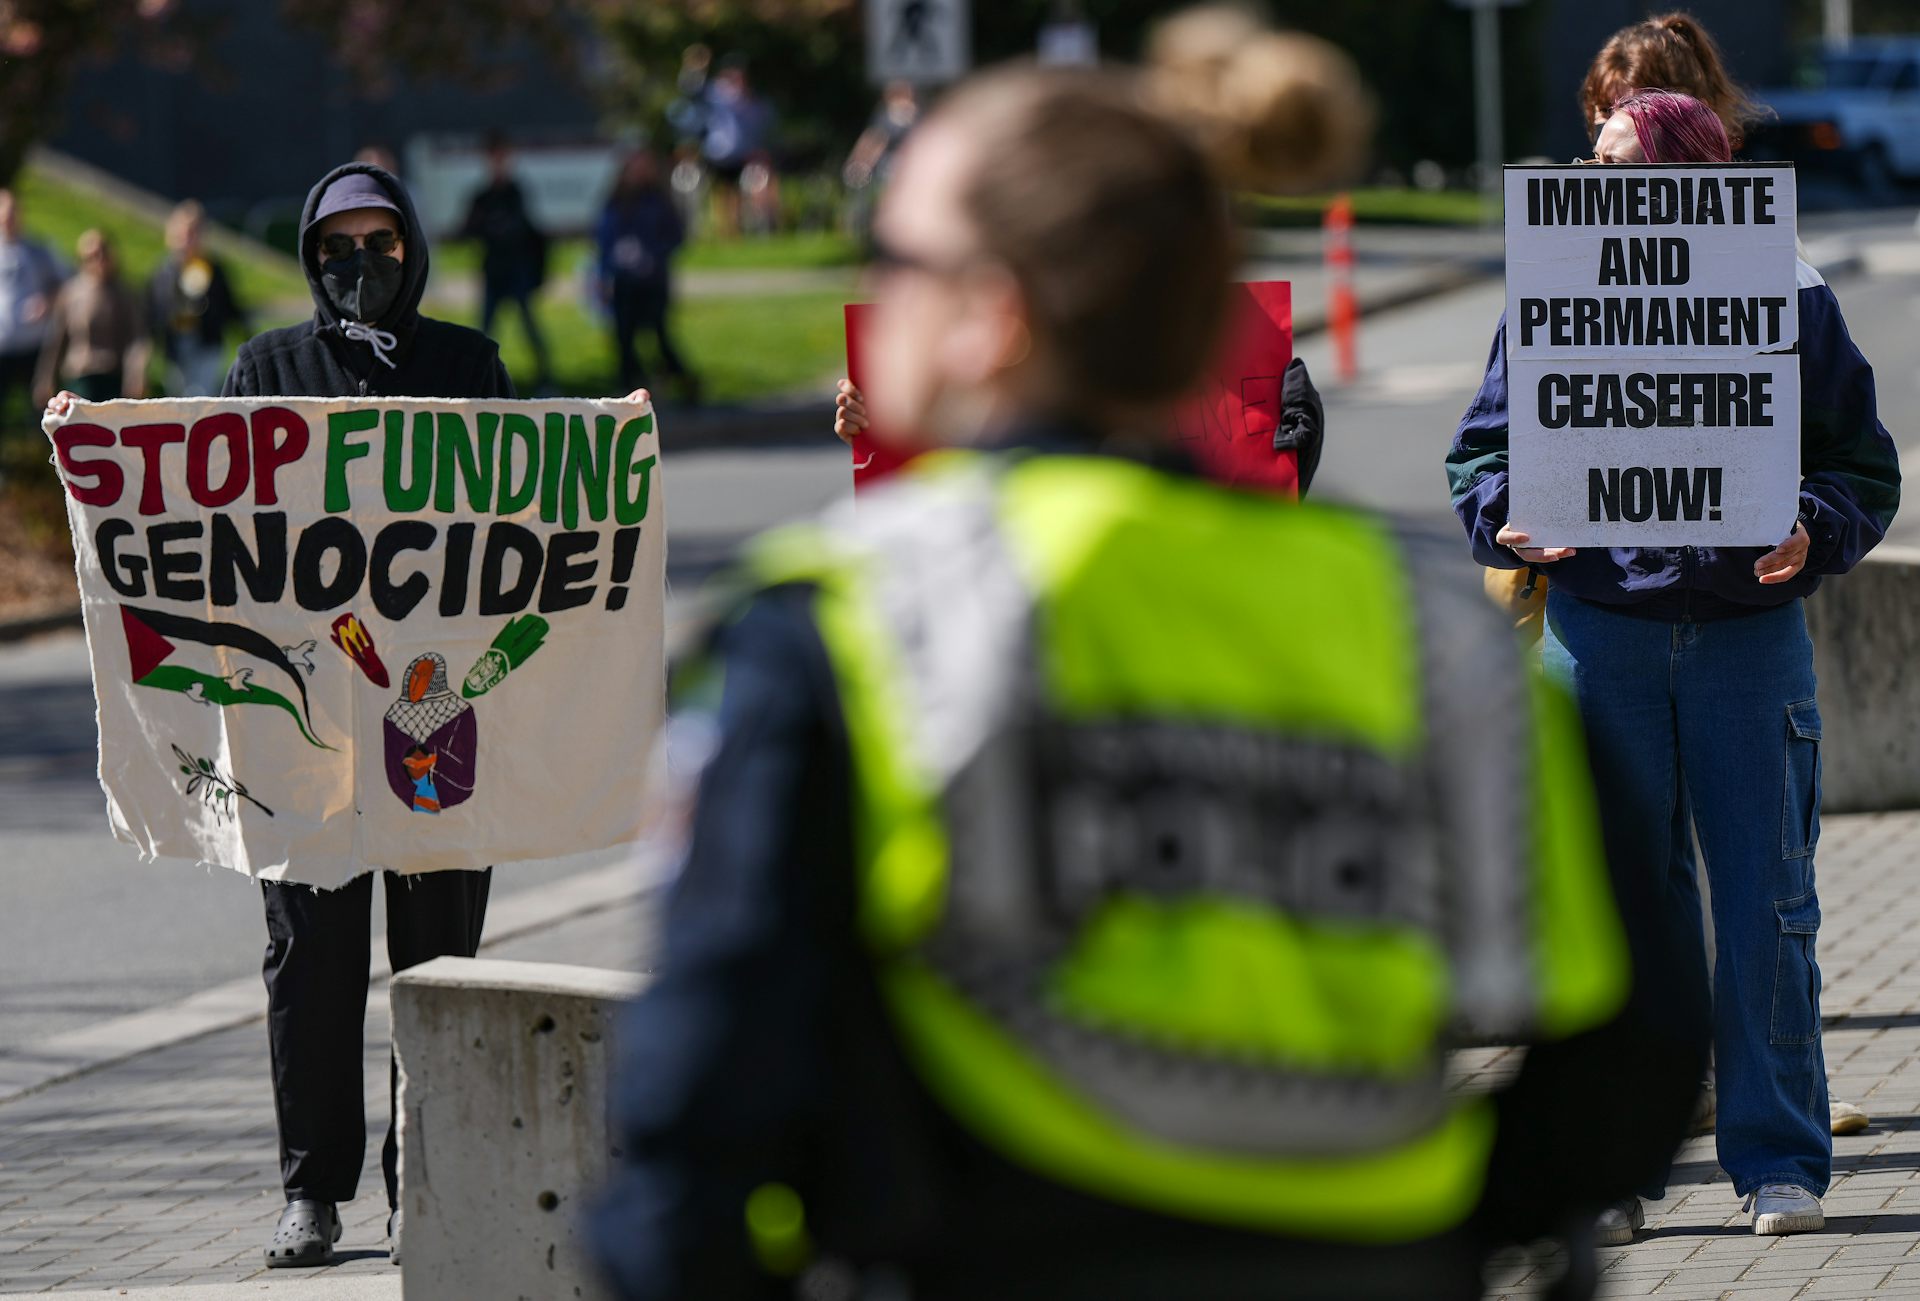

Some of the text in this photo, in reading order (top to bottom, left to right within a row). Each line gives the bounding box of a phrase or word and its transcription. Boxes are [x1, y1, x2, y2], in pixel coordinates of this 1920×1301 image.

[1527, 176, 1776, 226] IMMEDIATE
[1598, 237, 1690, 286] AND
[1520, 297, 1787, 347] PERMANENT
[1537, 372, 1774, 429] CEASEFIRE
[53, 406, 656, 531] STOP FUNDING
[1588, 466, 1723, 523] NOW!
[95, 511, 642, 621] GENOCIDE!
